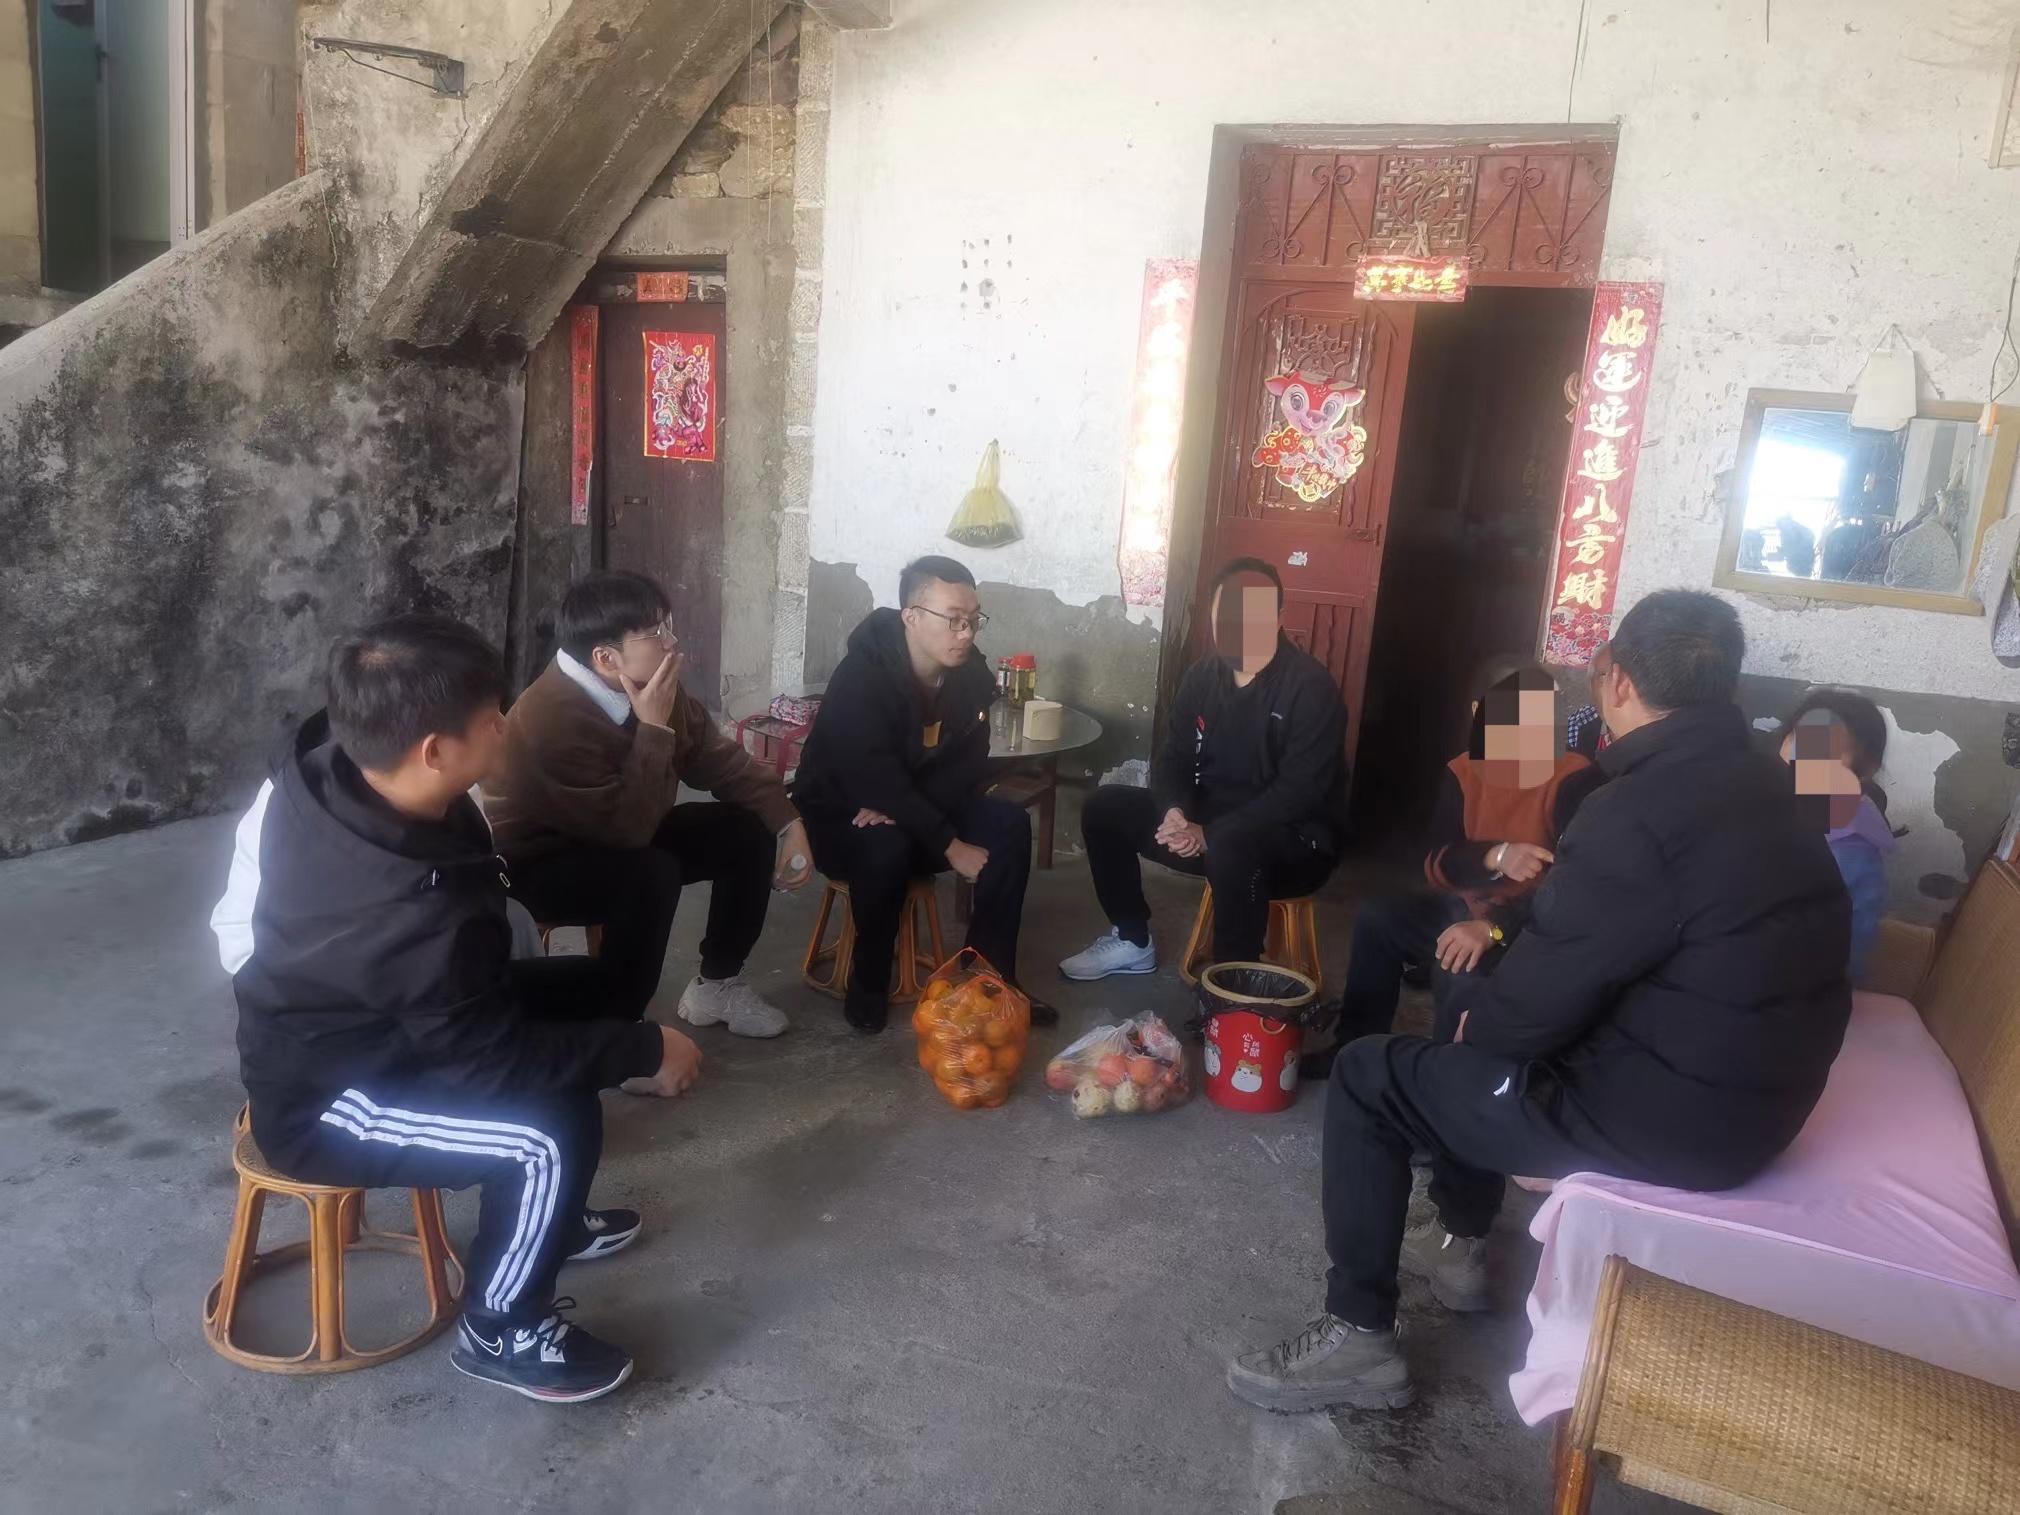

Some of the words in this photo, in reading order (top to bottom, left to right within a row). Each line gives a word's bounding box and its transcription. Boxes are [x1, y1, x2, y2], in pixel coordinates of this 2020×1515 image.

[1557, 305, 1648, 609] 好運迎進八方財
